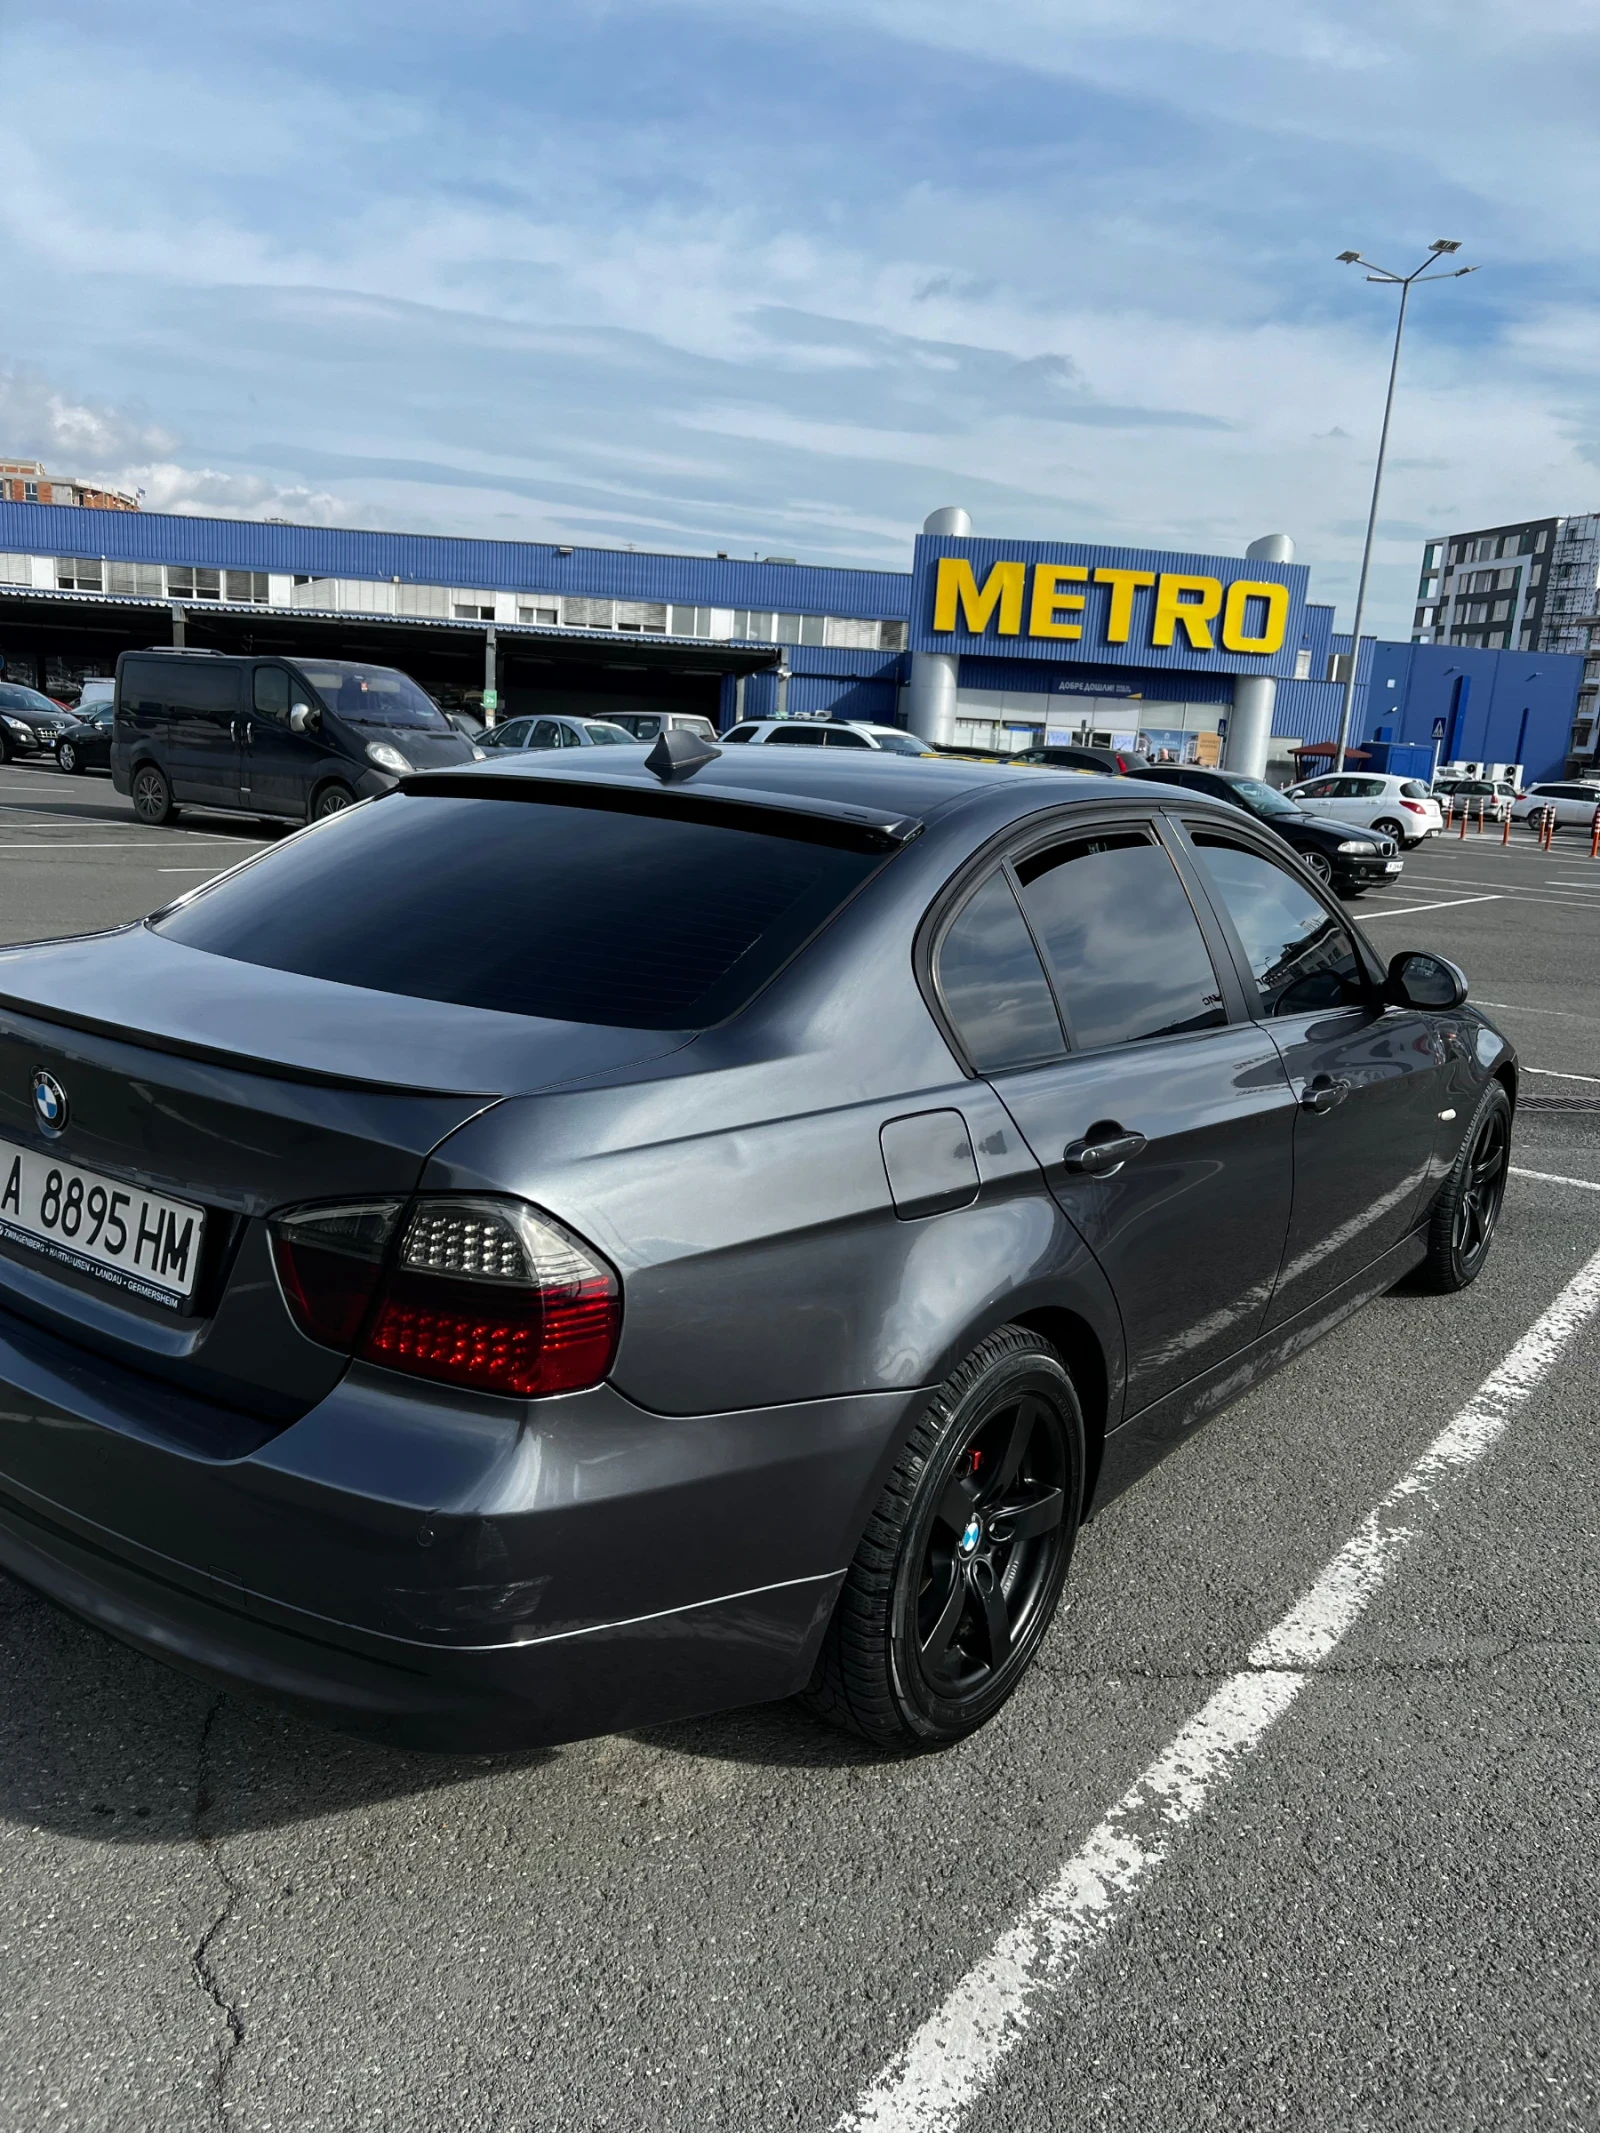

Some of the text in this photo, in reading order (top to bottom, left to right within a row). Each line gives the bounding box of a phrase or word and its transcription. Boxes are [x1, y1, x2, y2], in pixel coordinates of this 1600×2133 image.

[933, 558, 1289, 654] METRO
[1059, 681, 1084, 691] ДОБРЕ
[1084, 683, 1115, 692] ДОШЛИ!
[1, 1155, 194, 1282] A 8895 HM
[4, 1228, 178, 1309] ZWINGENBERG HARTHAUSEN LANDAU GERMERSHEIM
